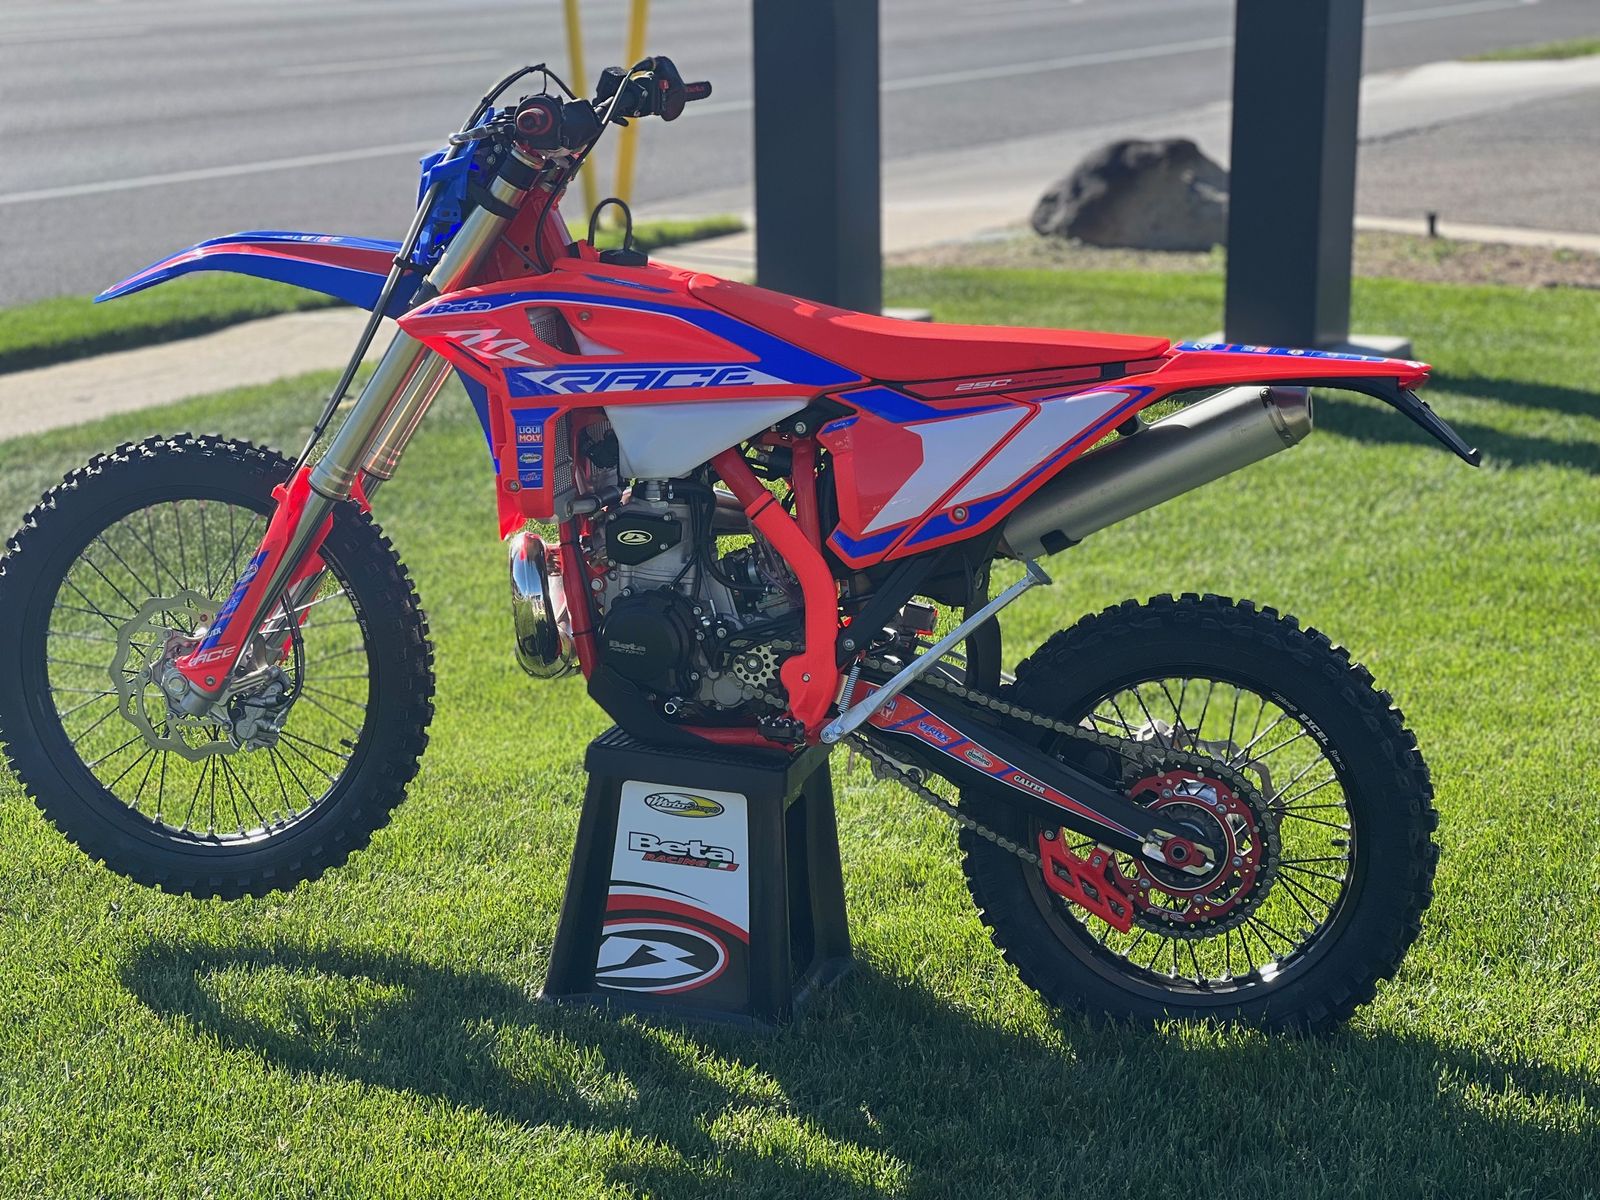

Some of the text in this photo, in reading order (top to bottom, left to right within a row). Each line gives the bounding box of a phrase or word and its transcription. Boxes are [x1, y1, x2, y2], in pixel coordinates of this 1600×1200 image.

[431, 300, 492, 315] Beta
[541, 367, 755, 395] RACE
[519, 426, 541, 434] LIQUI
[519, 434, 541, 442] MOLY
[918, 720, 951, 744] VERTEX
[1299, 713, 1329, 746] EXCEL
[1013, 774, 1047, 794] GALFER
[628, 831, 734, 864] Beta
[643, 853, 709, 867] RACING
